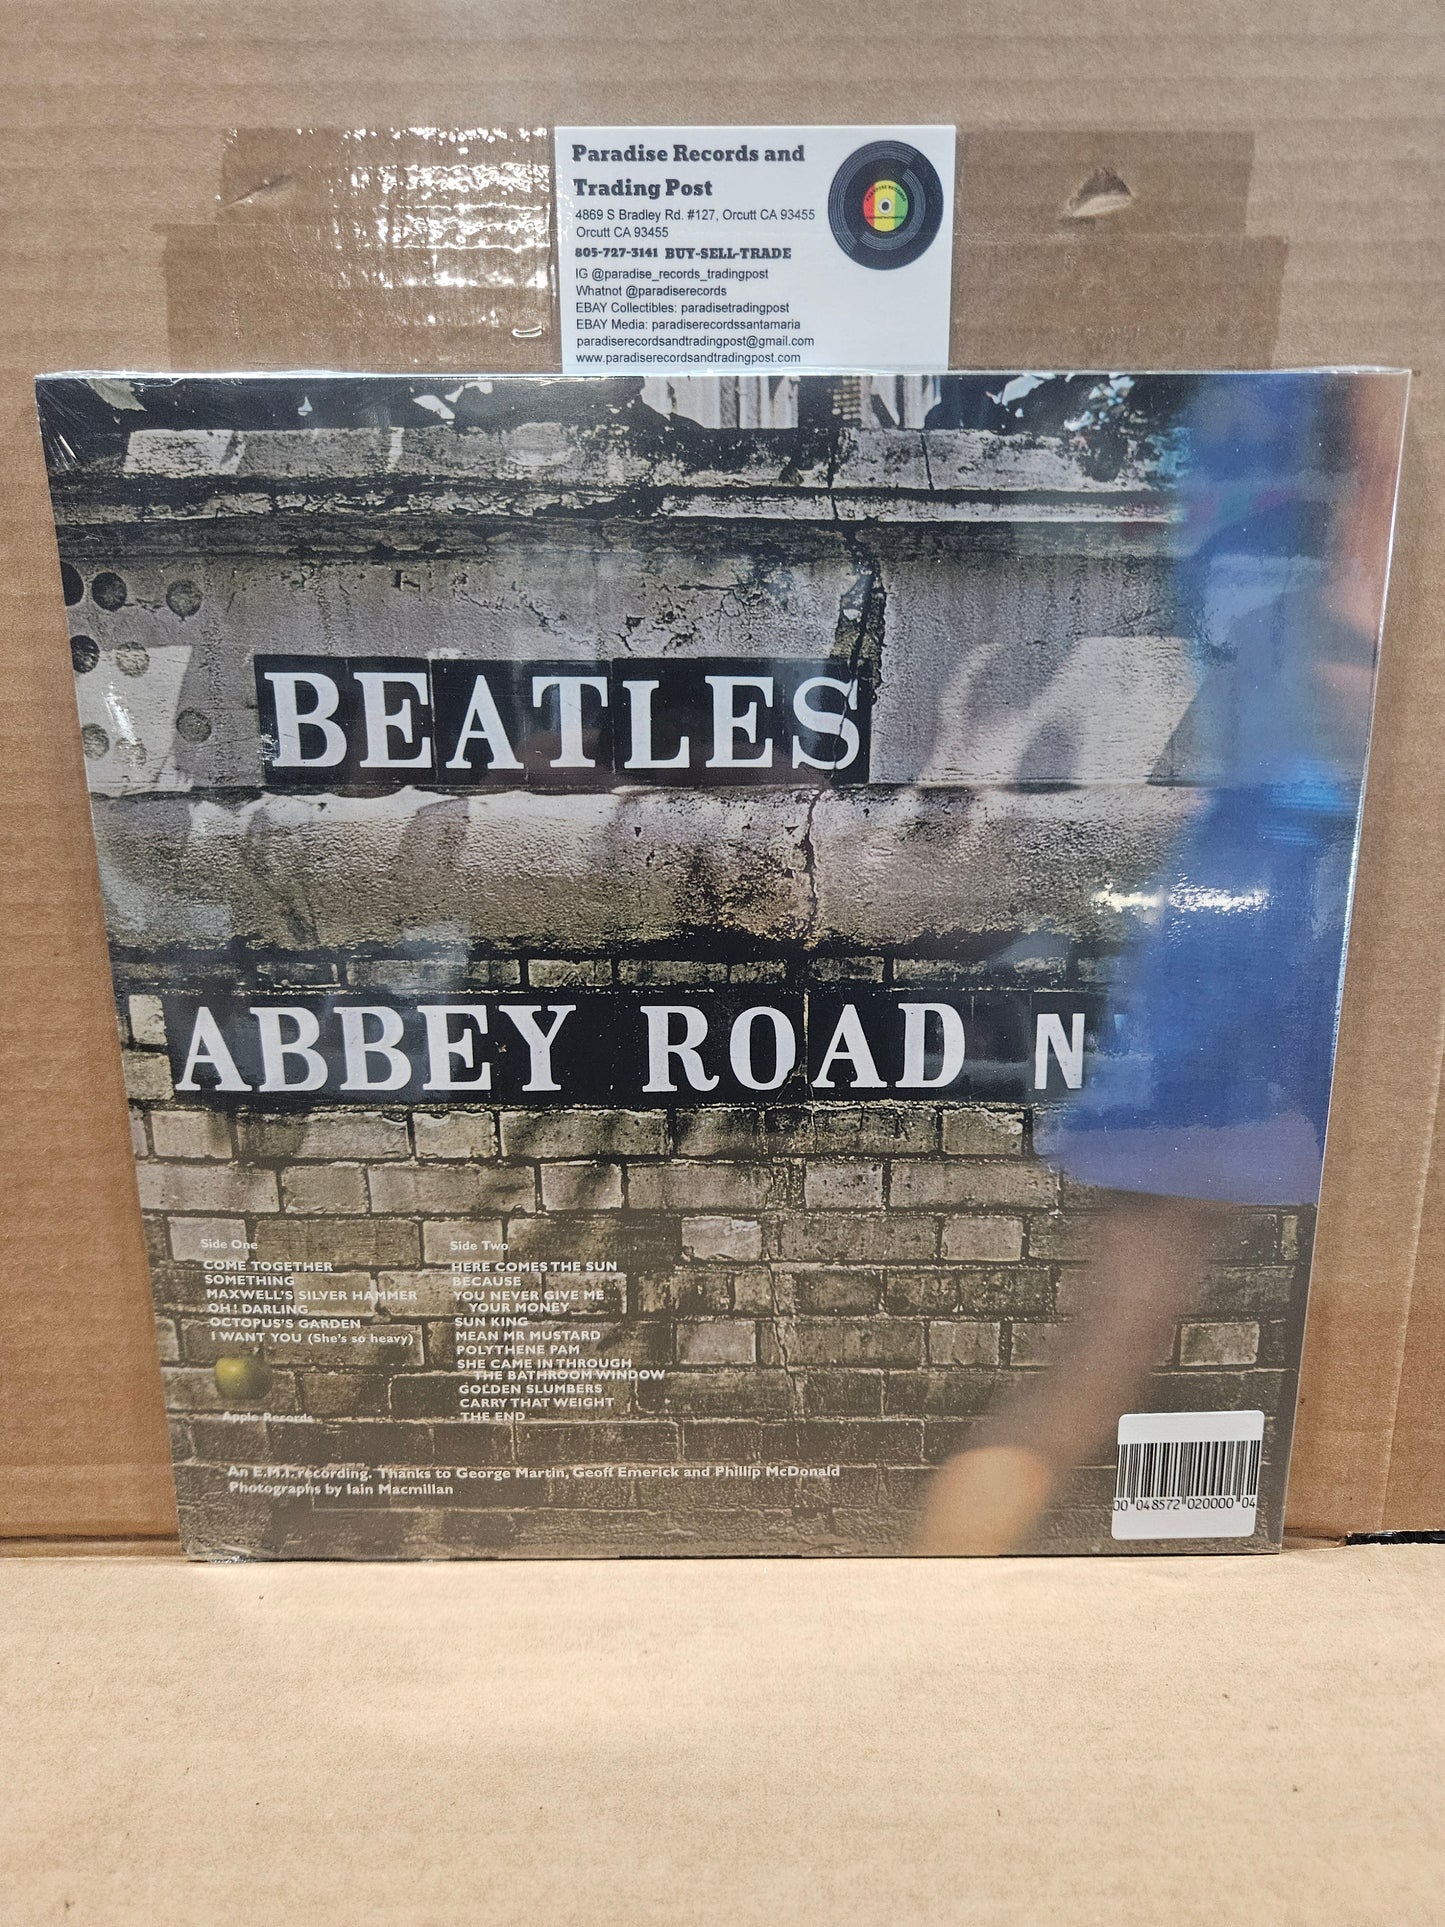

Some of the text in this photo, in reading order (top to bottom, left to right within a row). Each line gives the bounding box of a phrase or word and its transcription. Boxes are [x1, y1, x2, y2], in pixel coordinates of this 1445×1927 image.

[572, 144, 806, 162] Paradise Records and
[573, 178, 713, 200] Trading Post
[575, 209, 816, 223] 4869 S Bradley Rd. #127, Orcutt CA 93455
[576, 226, 669, 238] Orcutt CA 93455
[575, 248, 792, 259] 805-727-3141 BUY-SELL-TRADE
[576, 268, 769, 282] IG @paradise_records_tradingpost
[576, 285, 727, 299] Whatnot @paradiserecords
[576, 302, 789, 316] EBAY Collectibles: paradisetradingpost
[576, 319, 801, 333] EBAY Media: paradiserecordssantamaria
[577, 336, 814, 349] paradiserecordsandtradingpost@gmail.com
[576, 352, 801, 365] www.paradiserecordsandtradingpost.com
[264, 671, 861, 772] BEATLES
[174, 1002, 1087, 1093] ABBEY ROAD N
[201, 1239, 258, 1250] Side One
[450, 1241, 508, 1251] Side Two
[203, 1261, 333, 1272] COME TOGETHER
[451, 1261, 617, 1272] HERE COMES THE SUN
[204, 1275, 295, 1286] SOMETHING
[453, 1276, 521, 1287] BECAUSE
[299, 1290, 347, 1300] SILVER
[352, 1290, 417, 1300] HAMMER
[454, 1290, 605, 1301] YOU NEVER GIVE ME
[208, 1303, 309, 1314] OH! DARLING
[469, 1302, 570, 1313] YOUR MONEY
[299, 1319, 361, 1329] GARDEN
[454, 1317, 528, 1327] SUN KING
[211, 1332, 414, 1346] I WANT YOU (She's so heavy)
[456, 1330, 601, 1341] MEAN MR MUSTARD
[456, 1344, 580, 1355] POLYTHENE PAM
[457, 1358, 632, 1369] SHE CAME IN THROUGH
[474, 1370, 666, 1380] THE BATHROOM WINDOW
[459, 1383, 603, 1394] GOLDEN SLUMBERS
[460, 1397, 614, 1408] CARRY THAT WEIGHT
[222, 1412, 313, 1424] Apple Records
[460, 1411, 525, 1422] THE END
[227, 1465, 249, 1478] An
[298, 1467, 372, 1482] recording.
[379, 1468, 431, 1479] Thanks
[435, 1470, 451, 1479] to
[456, 1468, 511, 1481] George
[515, 1467, 569, 1480] Martin,
[573, 1467, 614, 1478] Geoff
[618, 1467, 679, 1478] Emerick
[684, 1466, 709, 1477] and
[715, 1466, 760, 1479] Phillip
[766, 1465, 840, 1477] McDonald
[229, 1481, 453, 1497] Photographs by Iain Macmillan
[1136, 1499, 1180, 1511] 048572
[1187, 1497, 1234, 1510] 020000
[1242, 1497, 1255, 1508] 04
